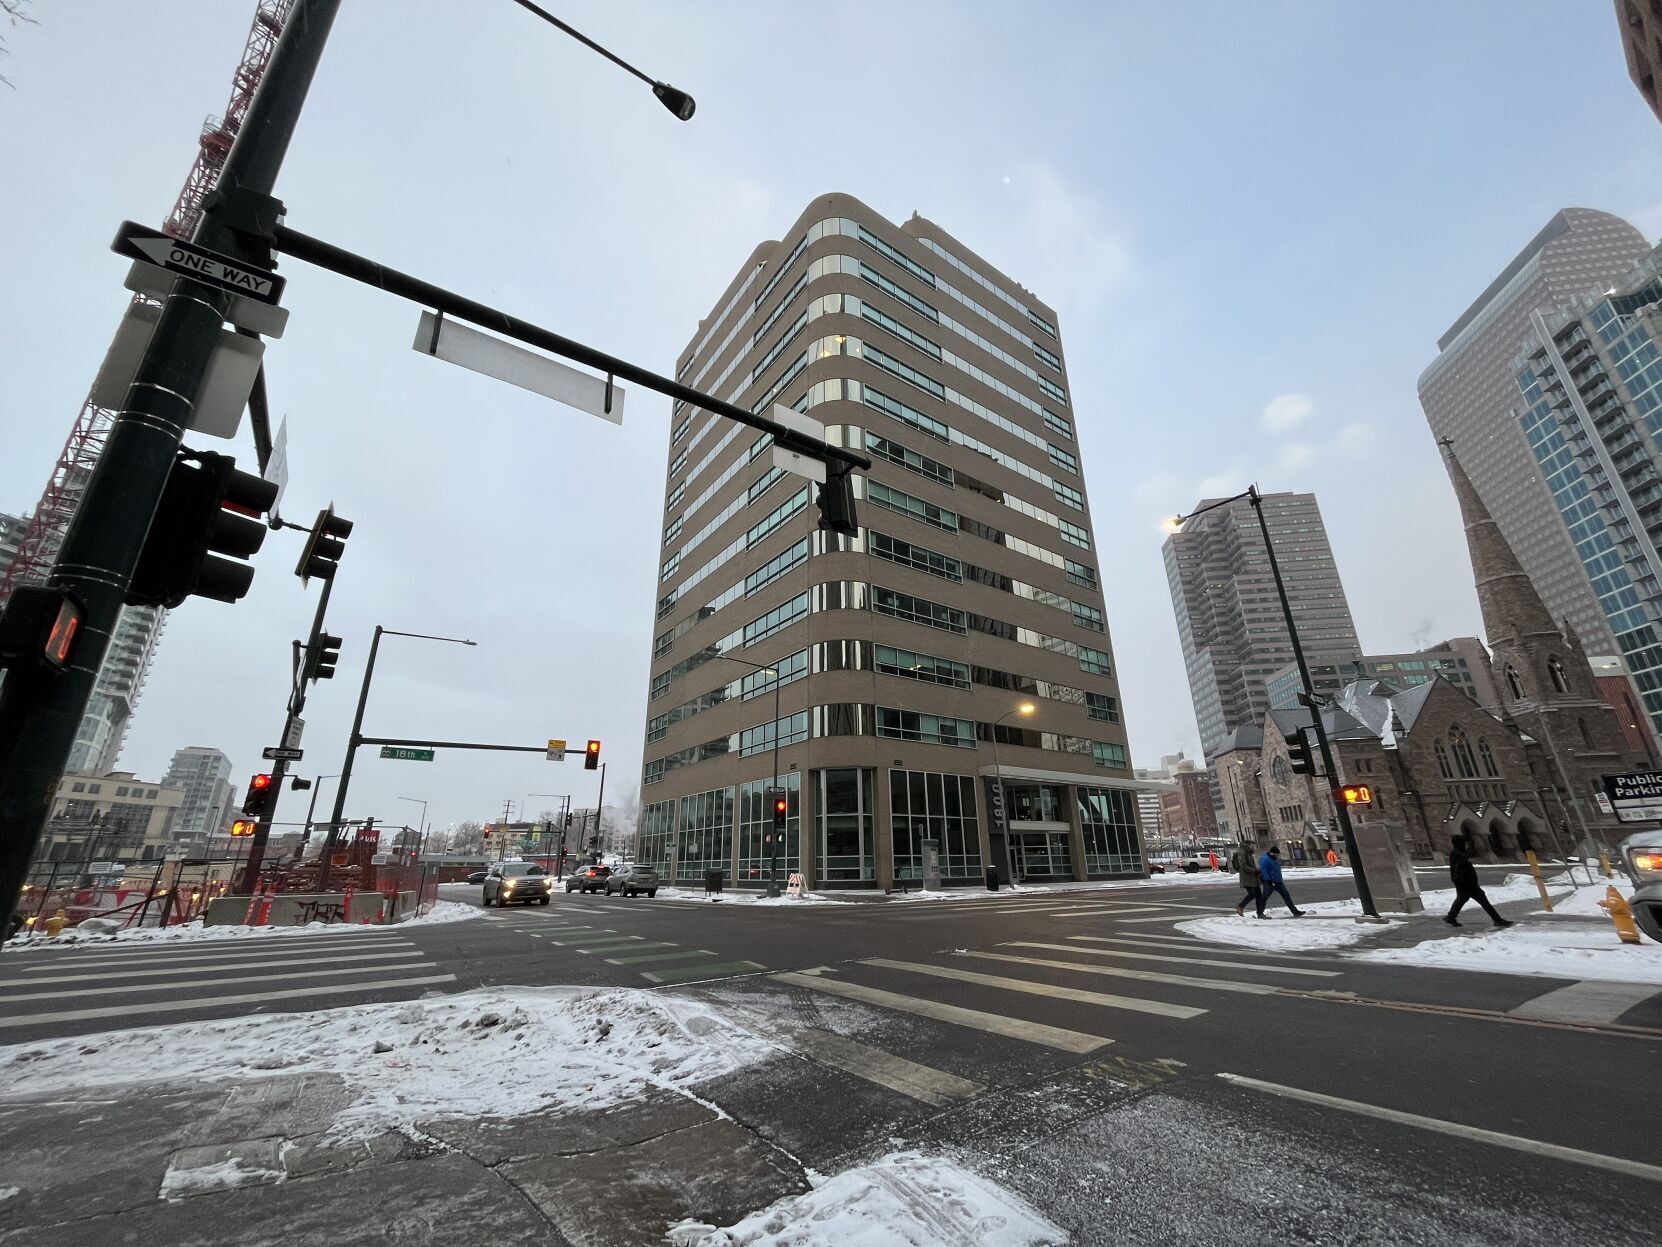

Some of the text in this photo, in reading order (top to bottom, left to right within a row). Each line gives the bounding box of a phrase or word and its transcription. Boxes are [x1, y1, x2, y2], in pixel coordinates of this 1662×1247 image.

[169, 249, 267, 291] ONE WAY
[396, 749, 416, 759] 18th
[1616, 774, 1662, 786] Public
[991, 783, 1005, 828] 1800
